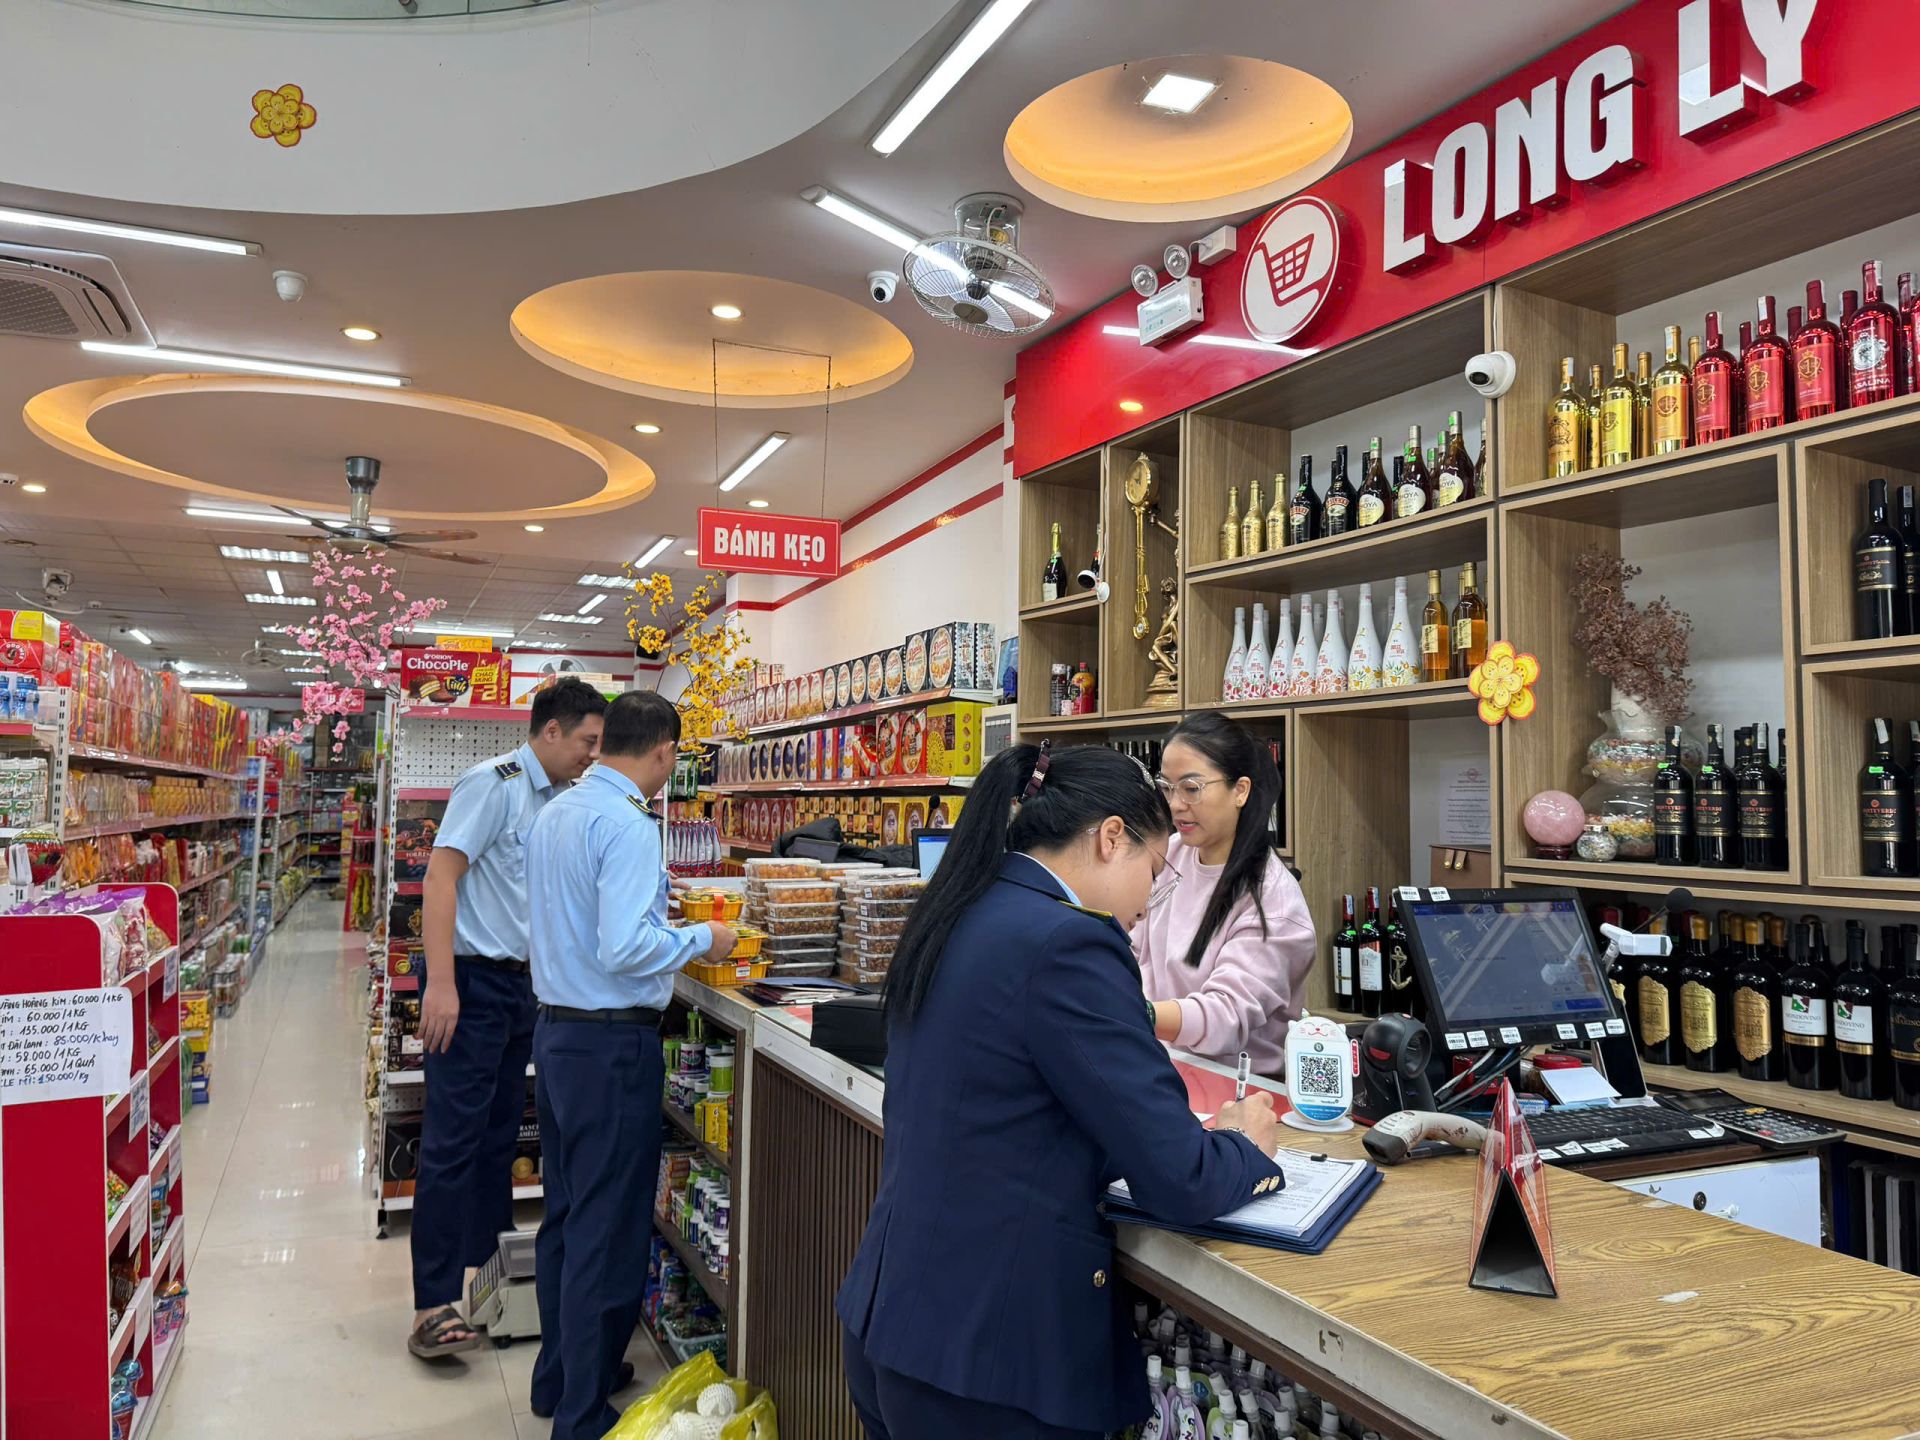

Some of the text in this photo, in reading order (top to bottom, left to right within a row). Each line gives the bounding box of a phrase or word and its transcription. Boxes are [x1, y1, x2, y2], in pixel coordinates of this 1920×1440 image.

[1384, 44, 1636, 273] LONG
[714, 523, 826, 567] BÁNH KẸO
[406, 657, 469, 671] ChocoPie
